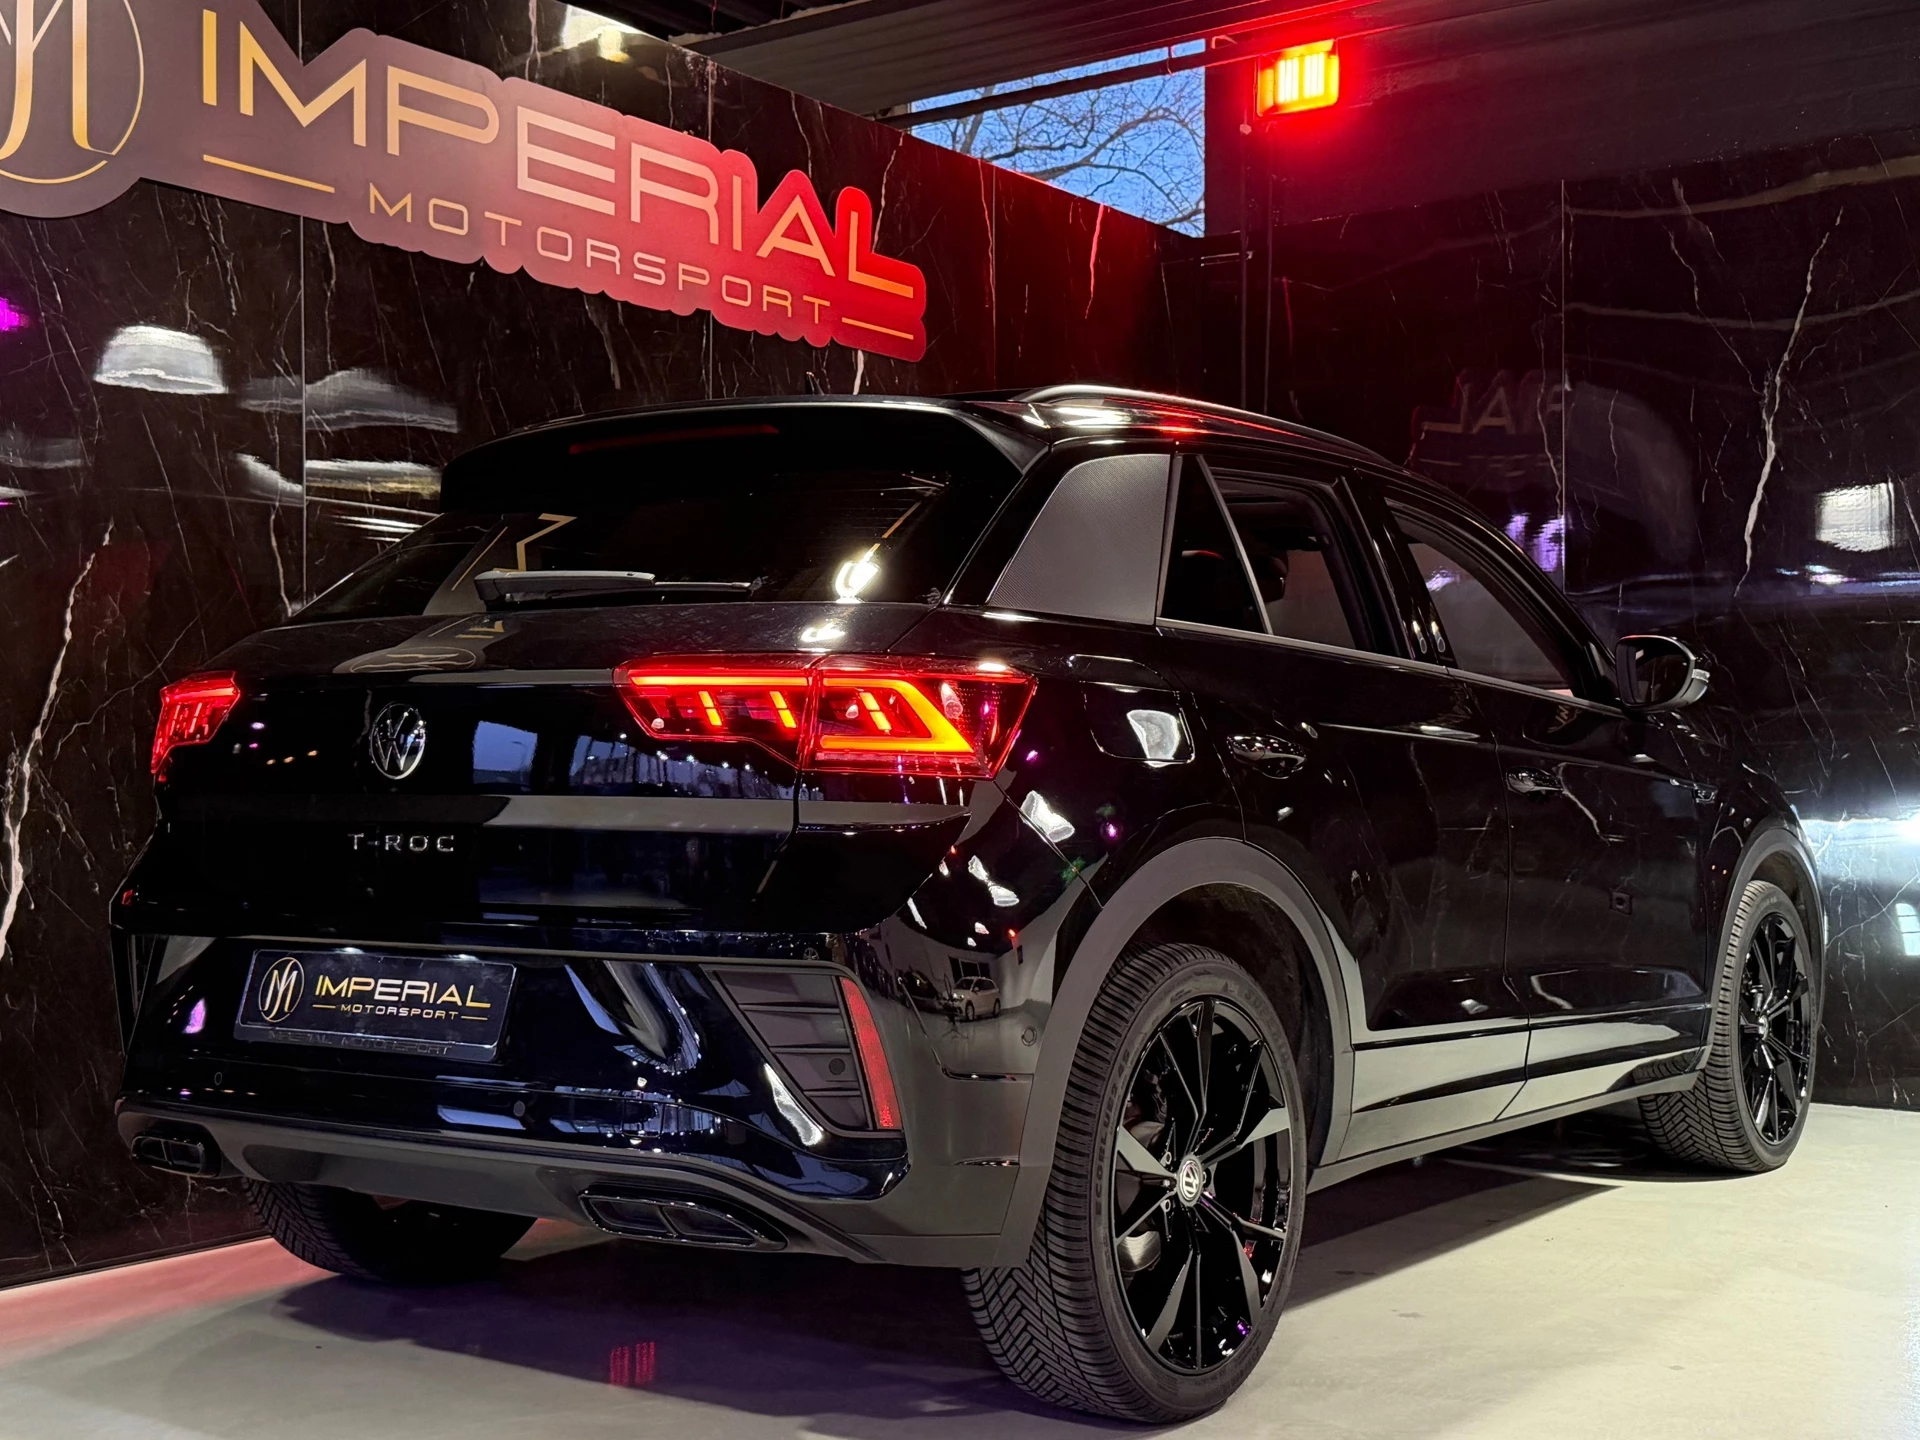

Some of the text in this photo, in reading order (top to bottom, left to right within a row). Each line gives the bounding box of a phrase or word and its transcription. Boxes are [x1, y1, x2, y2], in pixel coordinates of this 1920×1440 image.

[203, 9, 915, 299] IMPERIAL
[369, 182, 831, 325] MOTORSPORT
[347, 832, 455, 852] T-ROC
[314, 974, 492, 1009] IMPERIAL
[340, 1003, 459, 1021] MOTORSPORT
